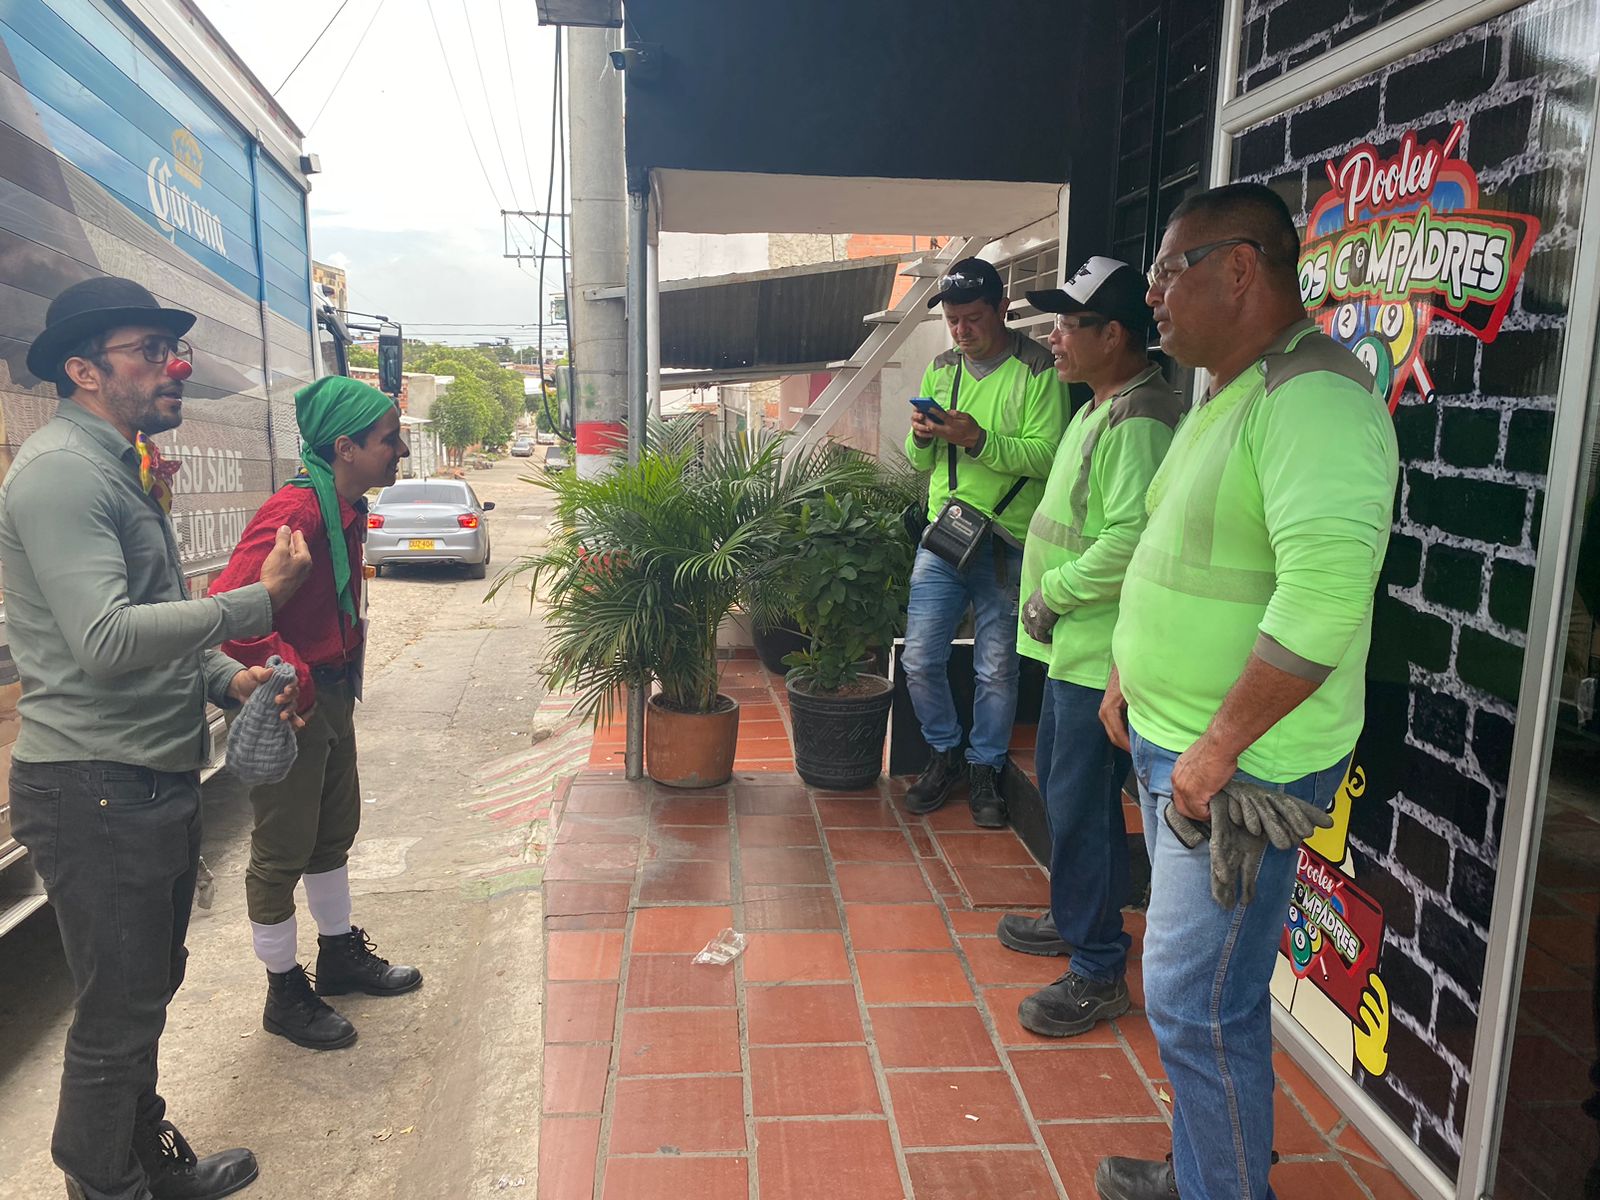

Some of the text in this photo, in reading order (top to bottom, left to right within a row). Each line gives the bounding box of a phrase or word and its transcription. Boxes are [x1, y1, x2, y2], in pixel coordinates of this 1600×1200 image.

[147, 157, 227, 256] Corona
[1340, 139, 1437, 221] Pooles
[1298, 215, 1506, 301] OS COMPADRES
[207, 446, 244, 492] SABE
[172, 509, 214, 558] EJOR
[1297, 848, 1334, 893] Pooles
[1292, 880, 1359, 959] OMPADRES
